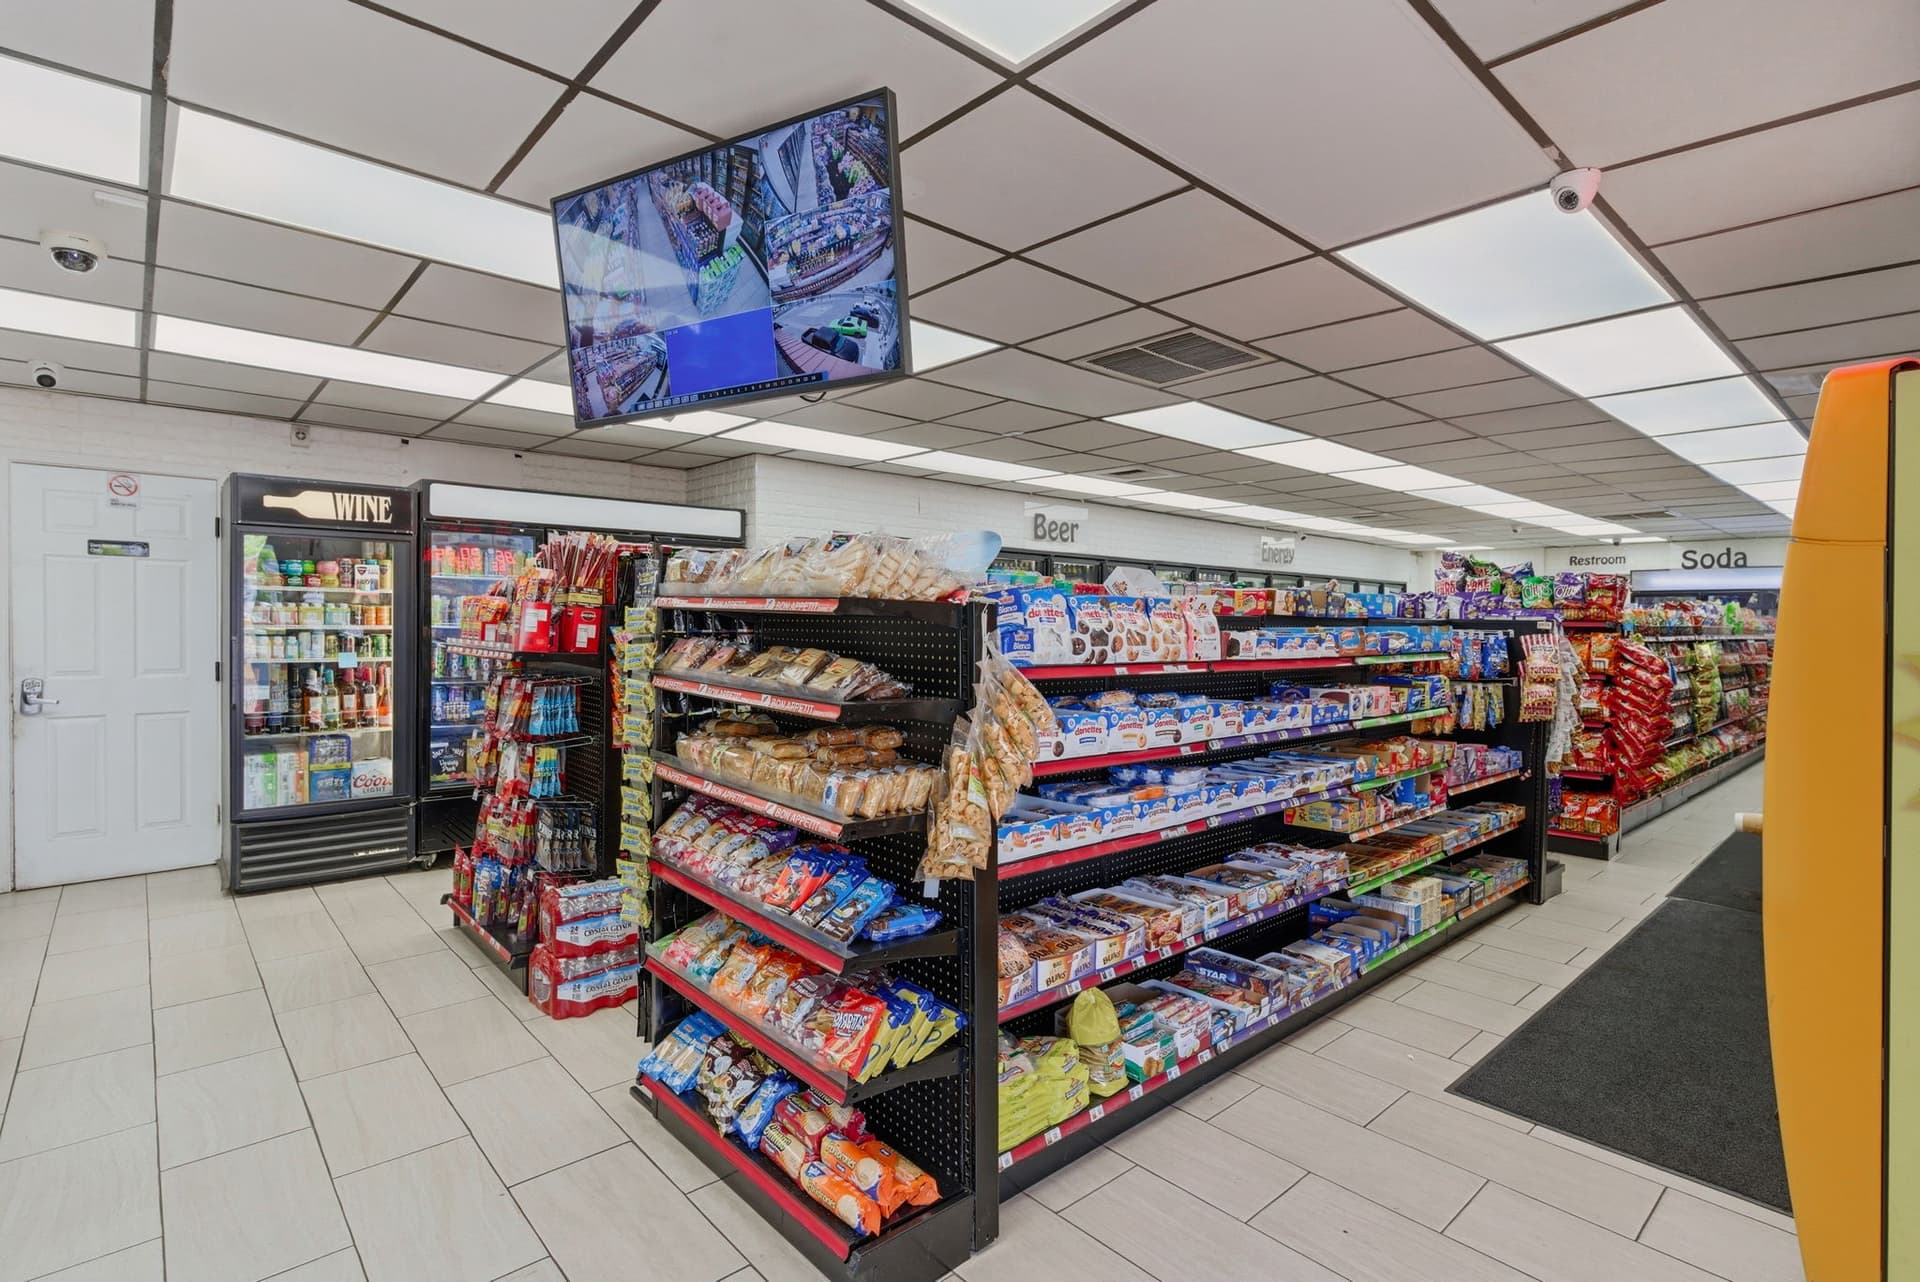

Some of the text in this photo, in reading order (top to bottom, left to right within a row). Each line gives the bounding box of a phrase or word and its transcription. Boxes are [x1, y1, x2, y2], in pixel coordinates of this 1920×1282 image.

[335, 492, 392, 524] WINE
[1033, 513, 1079, 543] Beer
[1261, 541, 1295, 565] Energy
[1569, 555, 1626, 567] Restroom
[1681, 547, 1747, 570] Soda
[1075, 727, 1103, 736] donettes
[362, 786, 386, 794] LIGHT
[775, 807, 821, 832] BON APPETIT
[1199, 967, 1228, 982] STAR
